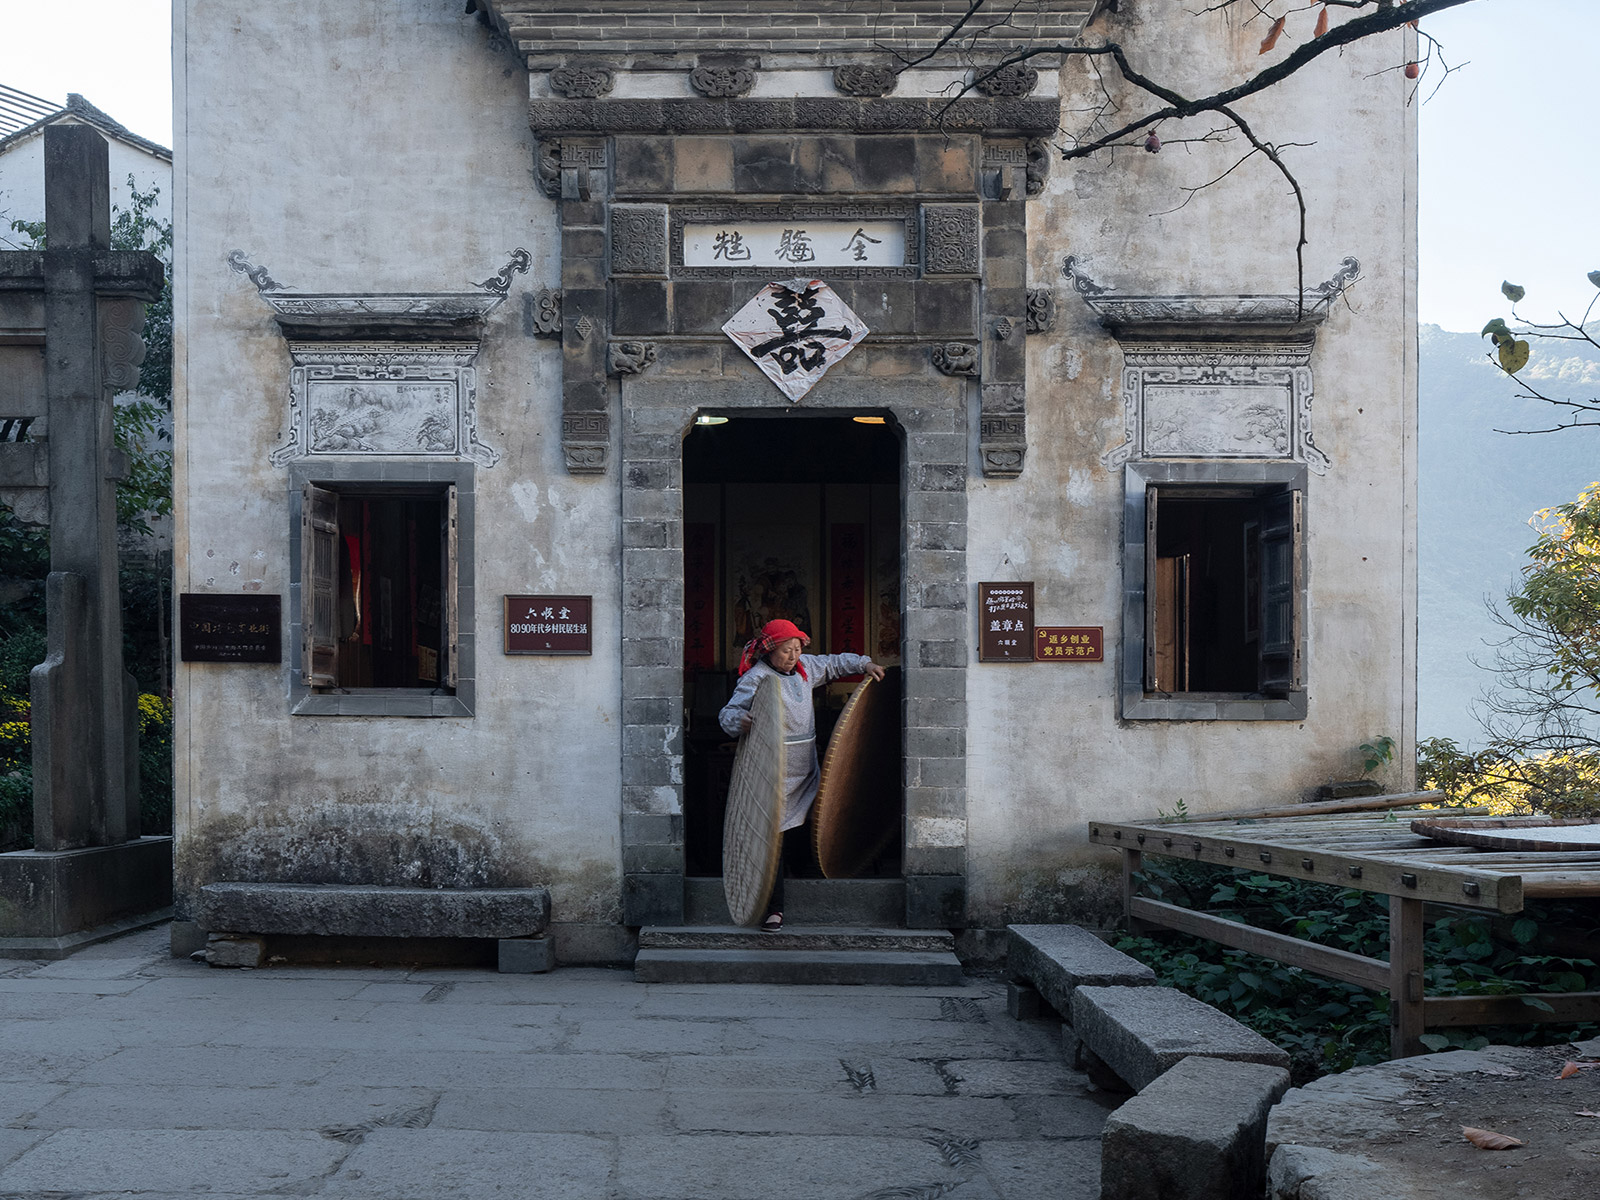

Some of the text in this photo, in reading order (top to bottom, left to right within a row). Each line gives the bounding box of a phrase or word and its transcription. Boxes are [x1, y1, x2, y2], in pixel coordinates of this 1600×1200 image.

[989, 619, 1024, 632] 盖章点
[1048, 634, 1090, 644] 返乡创业
[1043, 646, 1095, 656] 党员示范户
